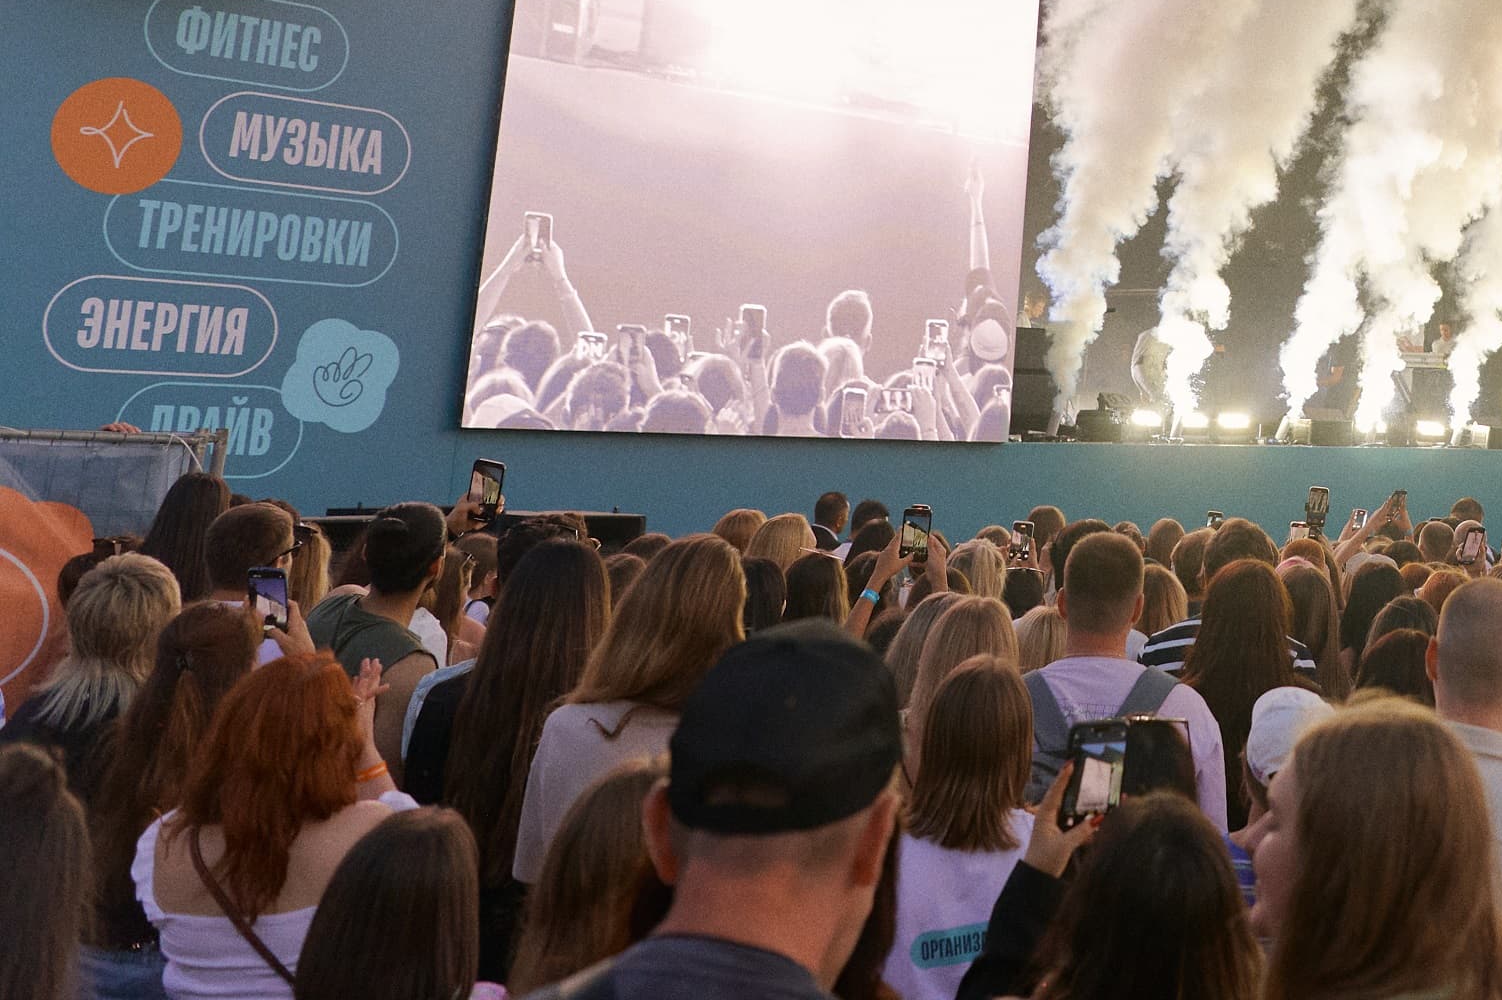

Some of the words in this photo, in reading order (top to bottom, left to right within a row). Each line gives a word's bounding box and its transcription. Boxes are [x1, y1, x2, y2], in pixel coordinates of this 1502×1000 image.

[176, 5, 322, 72] ФИТНЕС
[229, 112, 383, 175] МУЗЫКА
[138, 199, 373, 267] ТРЕНИРОВКИ
[77, 297, 249, 355] ЭНЕРГИЯ
